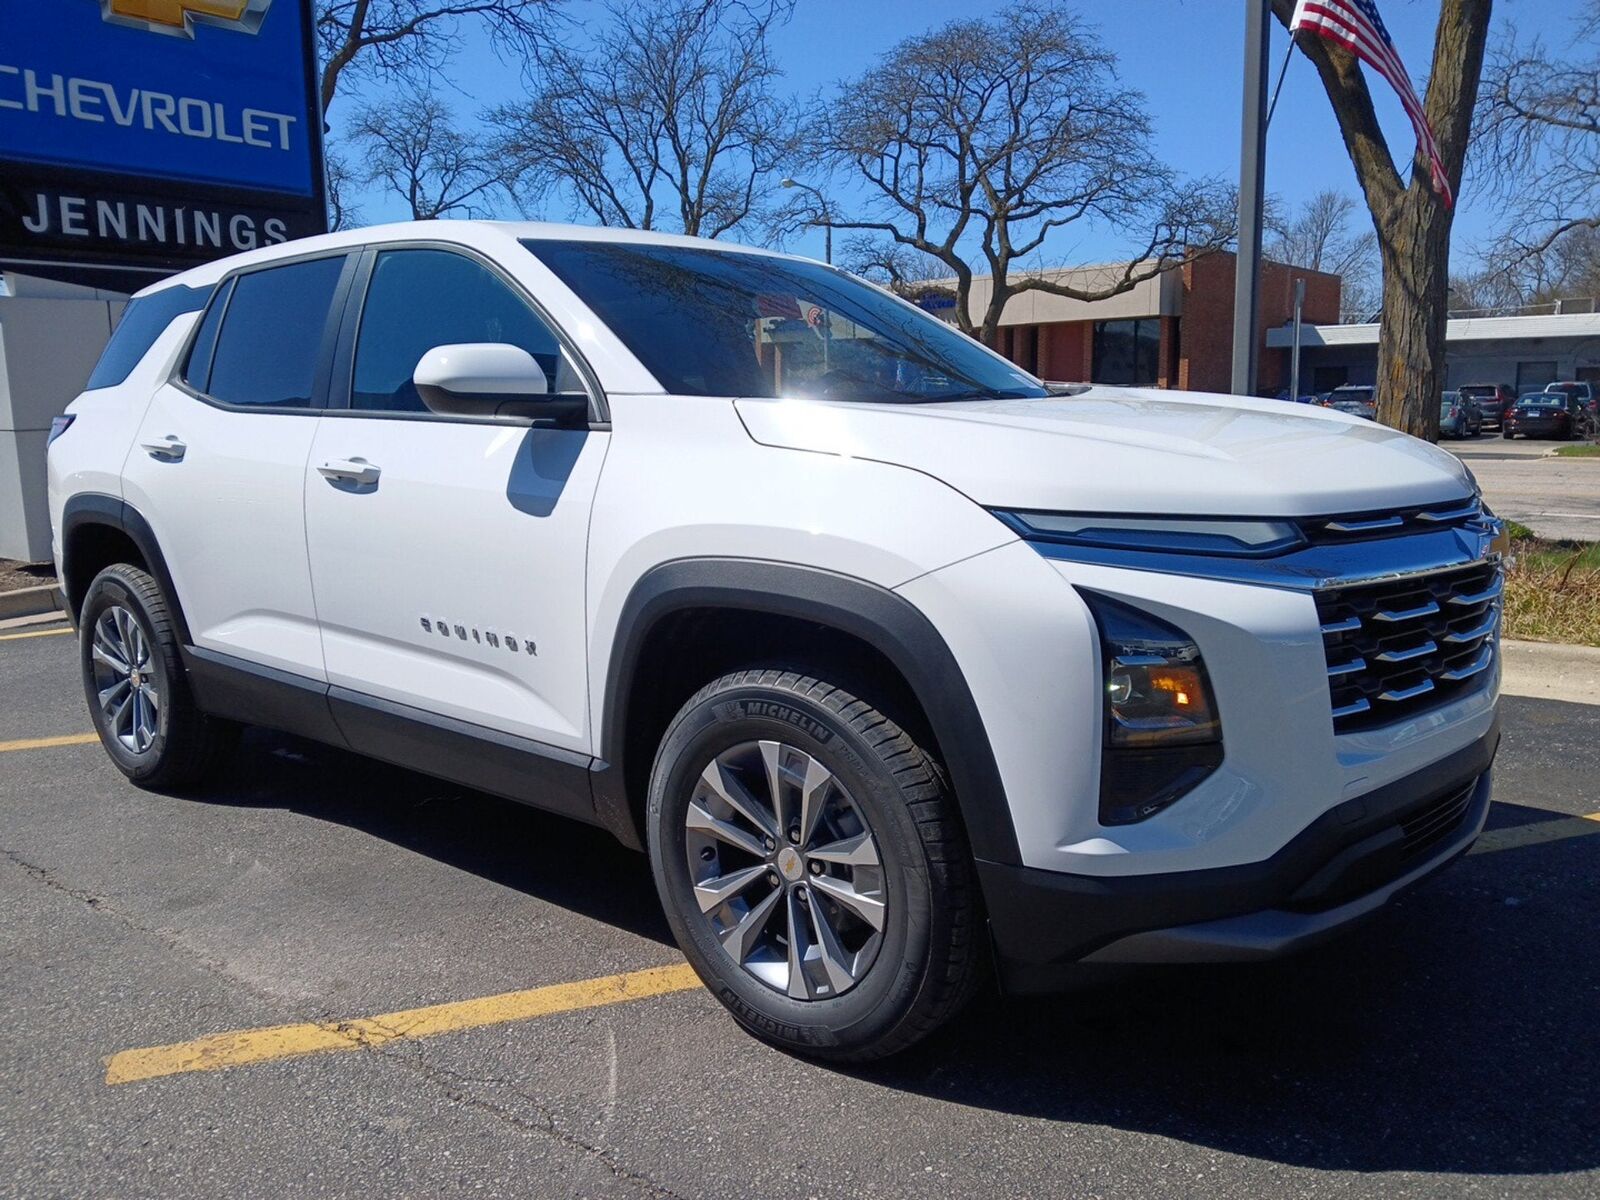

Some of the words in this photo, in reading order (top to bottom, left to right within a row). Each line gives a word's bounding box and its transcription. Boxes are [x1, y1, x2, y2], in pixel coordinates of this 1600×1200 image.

[22, 193, 287, 250] JENNINGS
[420, 617, 538, 656] EQUINOX
[747, 702, 830, 742] MICHELIN
[721, 988, 799, 1041] MICHELIN
